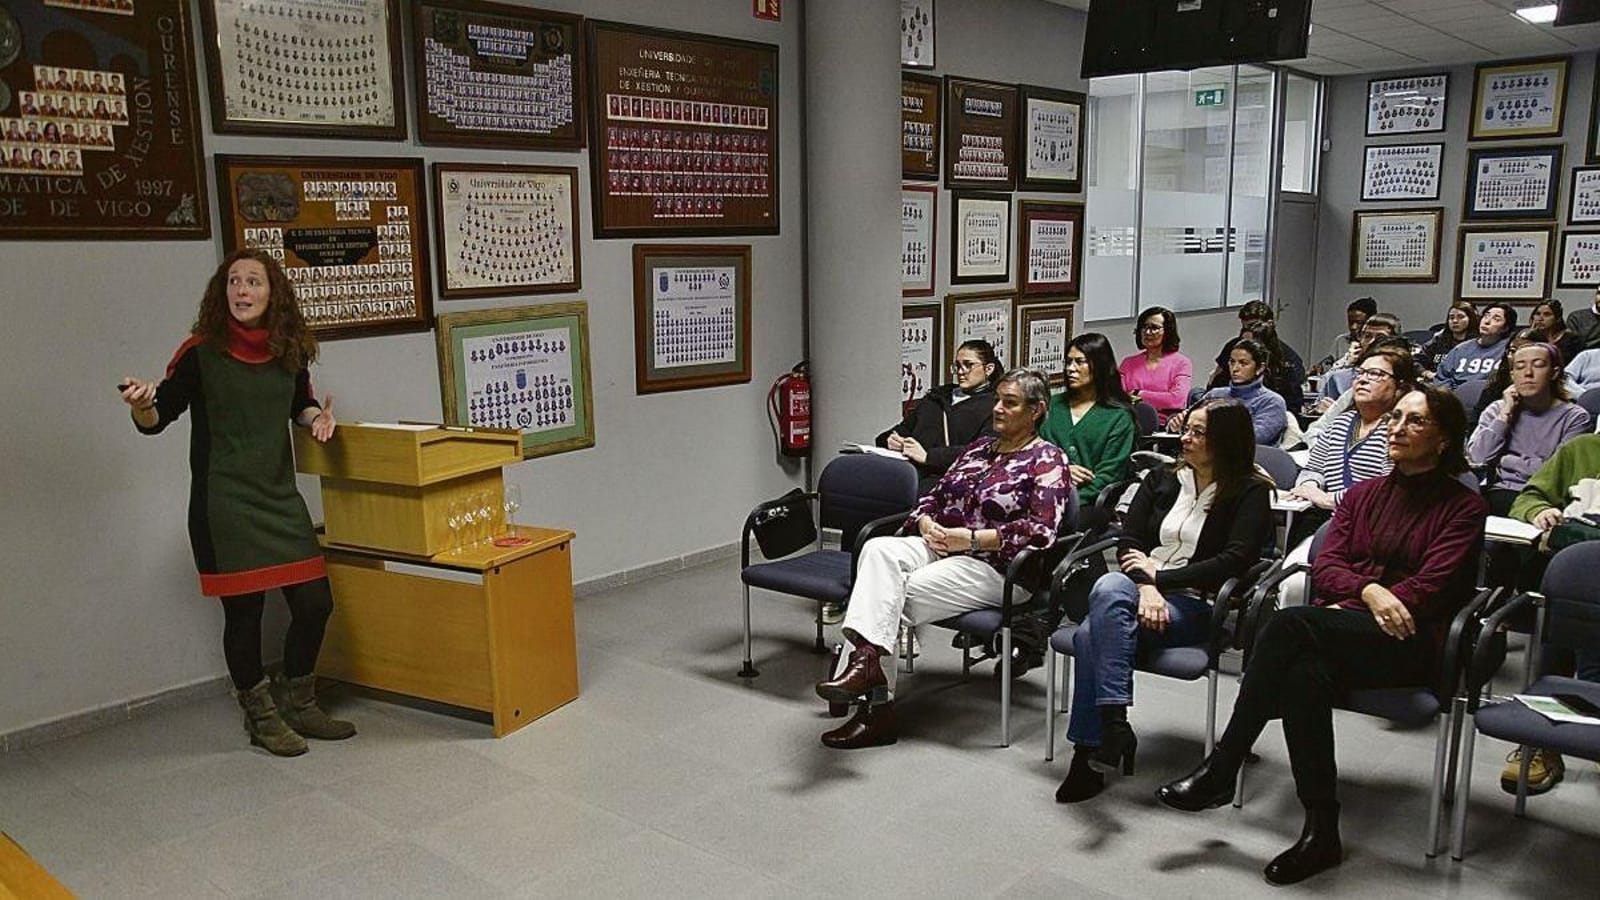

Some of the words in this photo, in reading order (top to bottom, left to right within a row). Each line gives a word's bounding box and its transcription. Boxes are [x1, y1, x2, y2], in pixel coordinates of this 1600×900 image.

[135, 180, 173, 196] 1997
[50, 199, 79, 216] DE
[96, 200, 151, 217] VIGO
